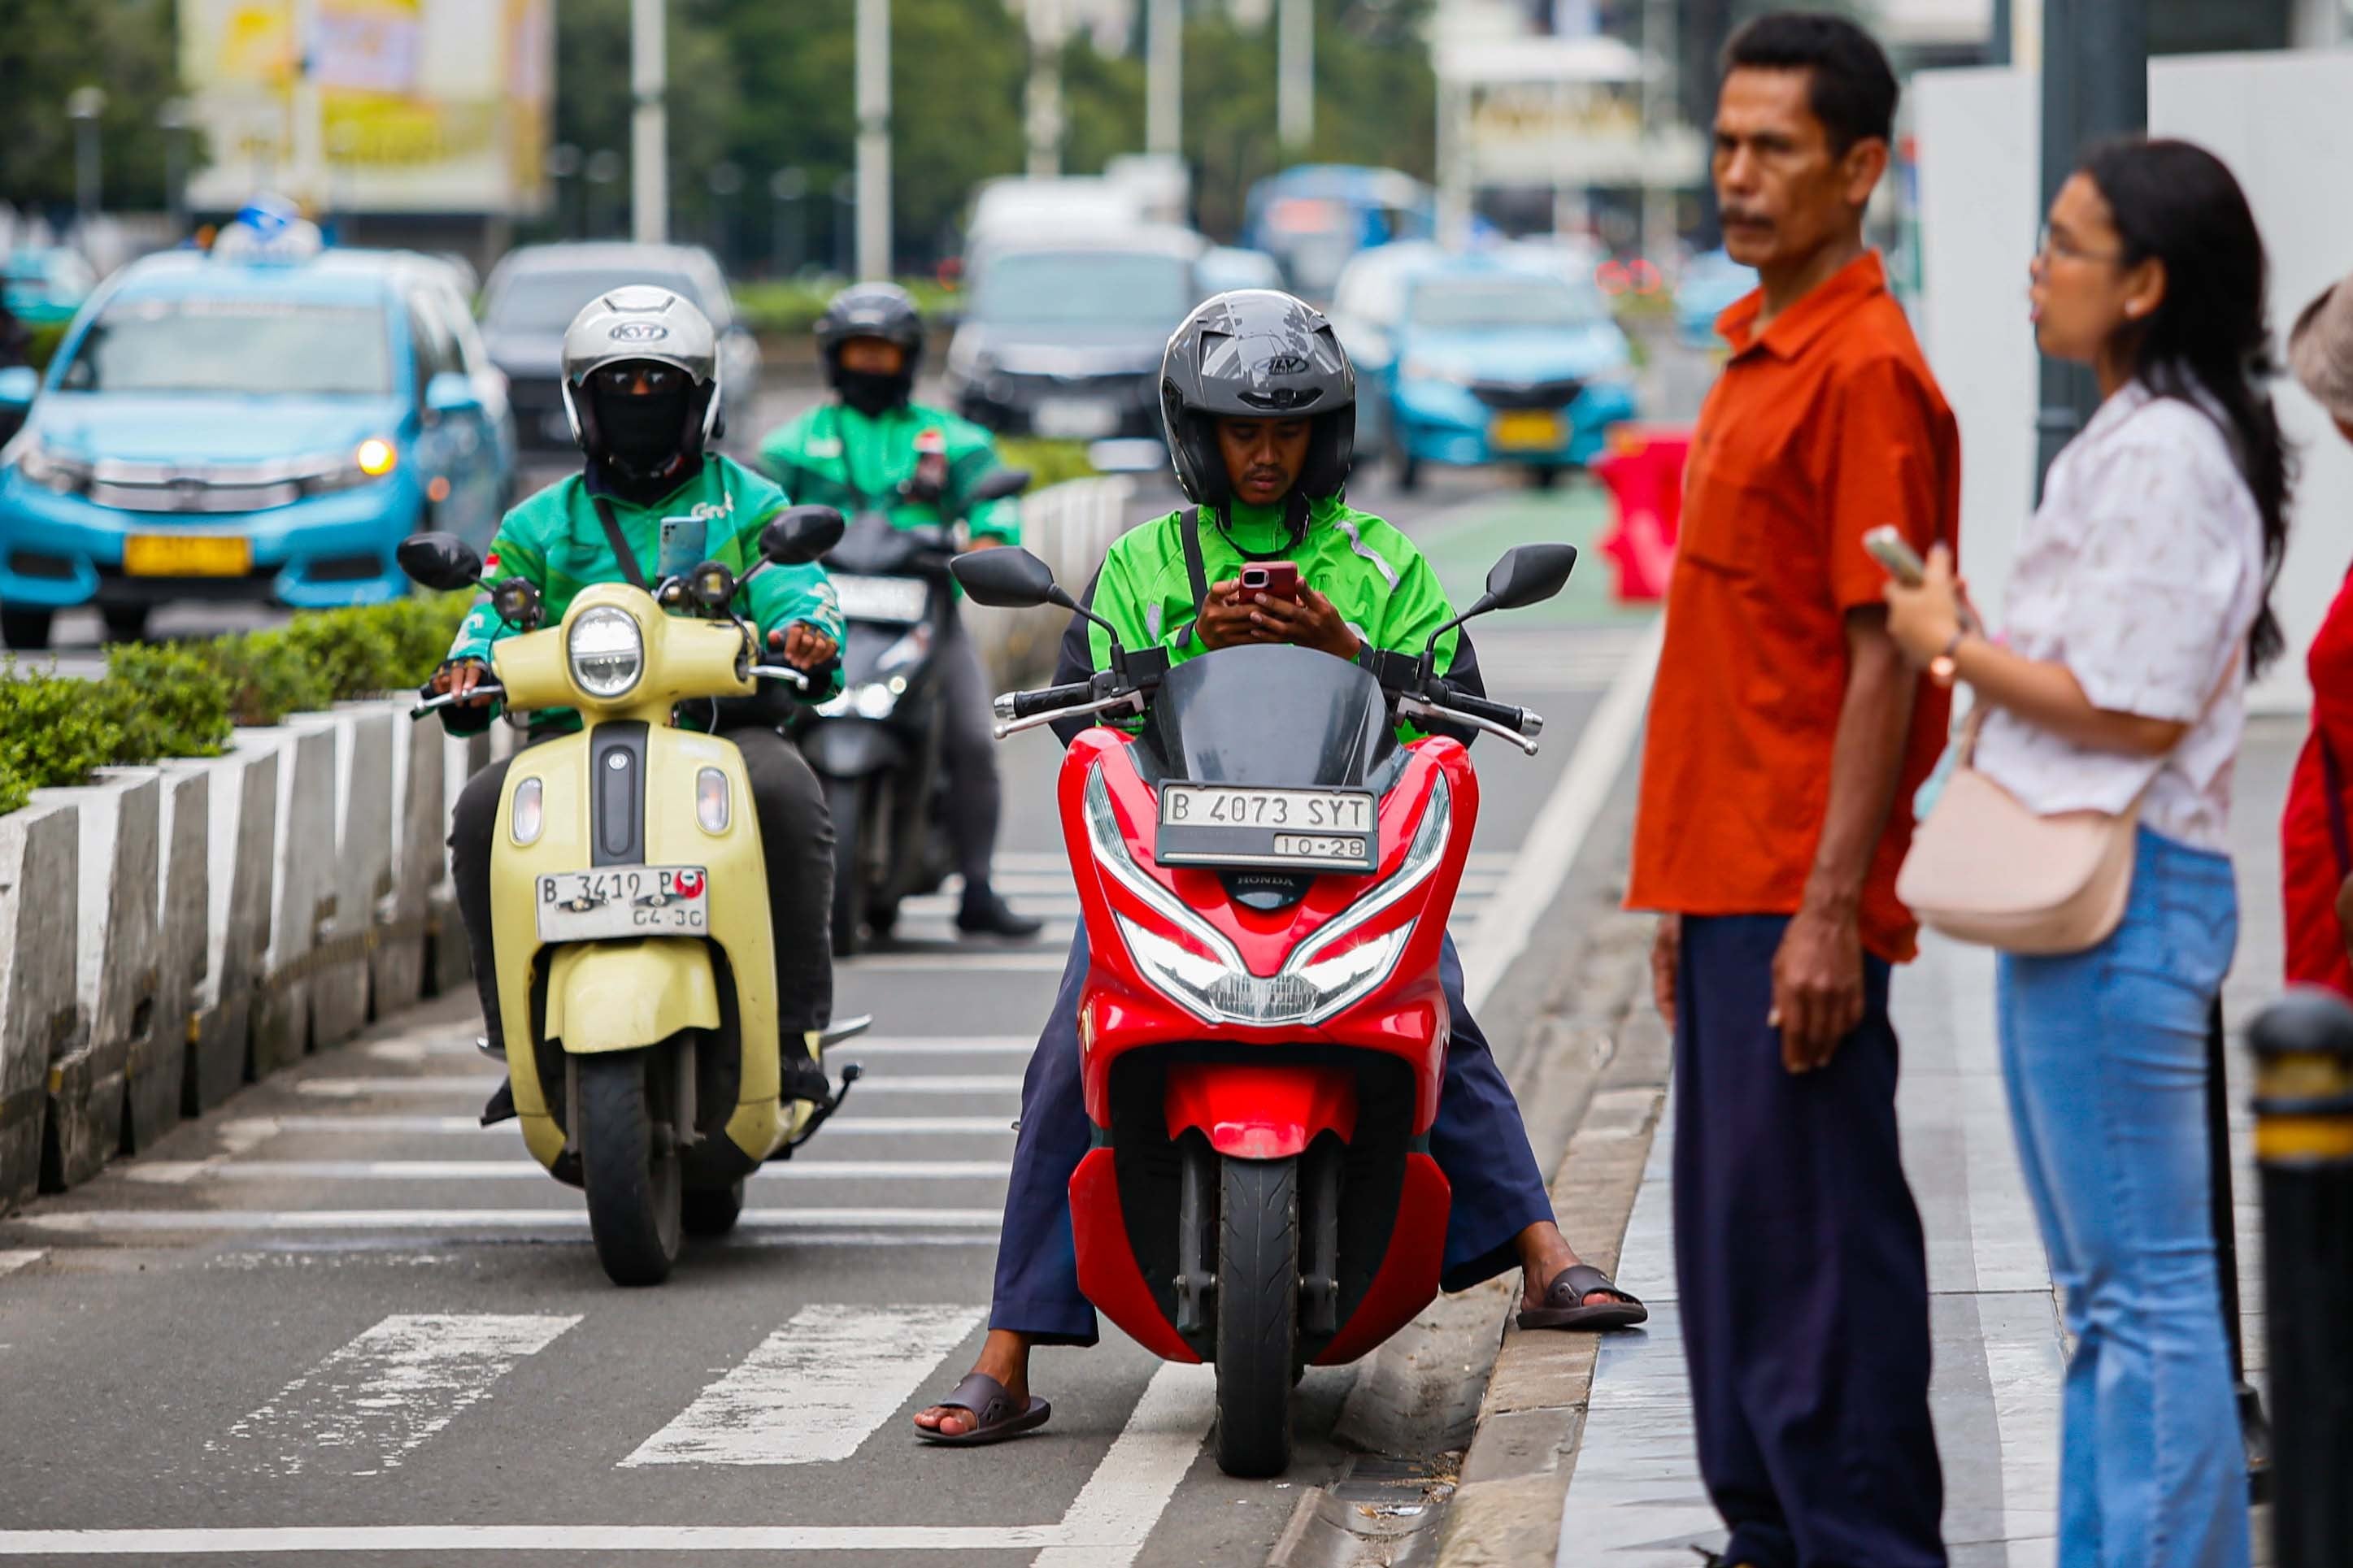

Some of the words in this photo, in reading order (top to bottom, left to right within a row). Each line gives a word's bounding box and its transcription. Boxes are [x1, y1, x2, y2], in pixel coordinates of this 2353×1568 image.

[616, 325, 659, 340] KYT
[1172, 793, 1190, 820] B
[1209, 795, 1289, 824] 4073
[1307, 799, 1364, 827] SYT
[1237, 875, 1294, 886] HONDA
[543, 878, 558, 904] B
